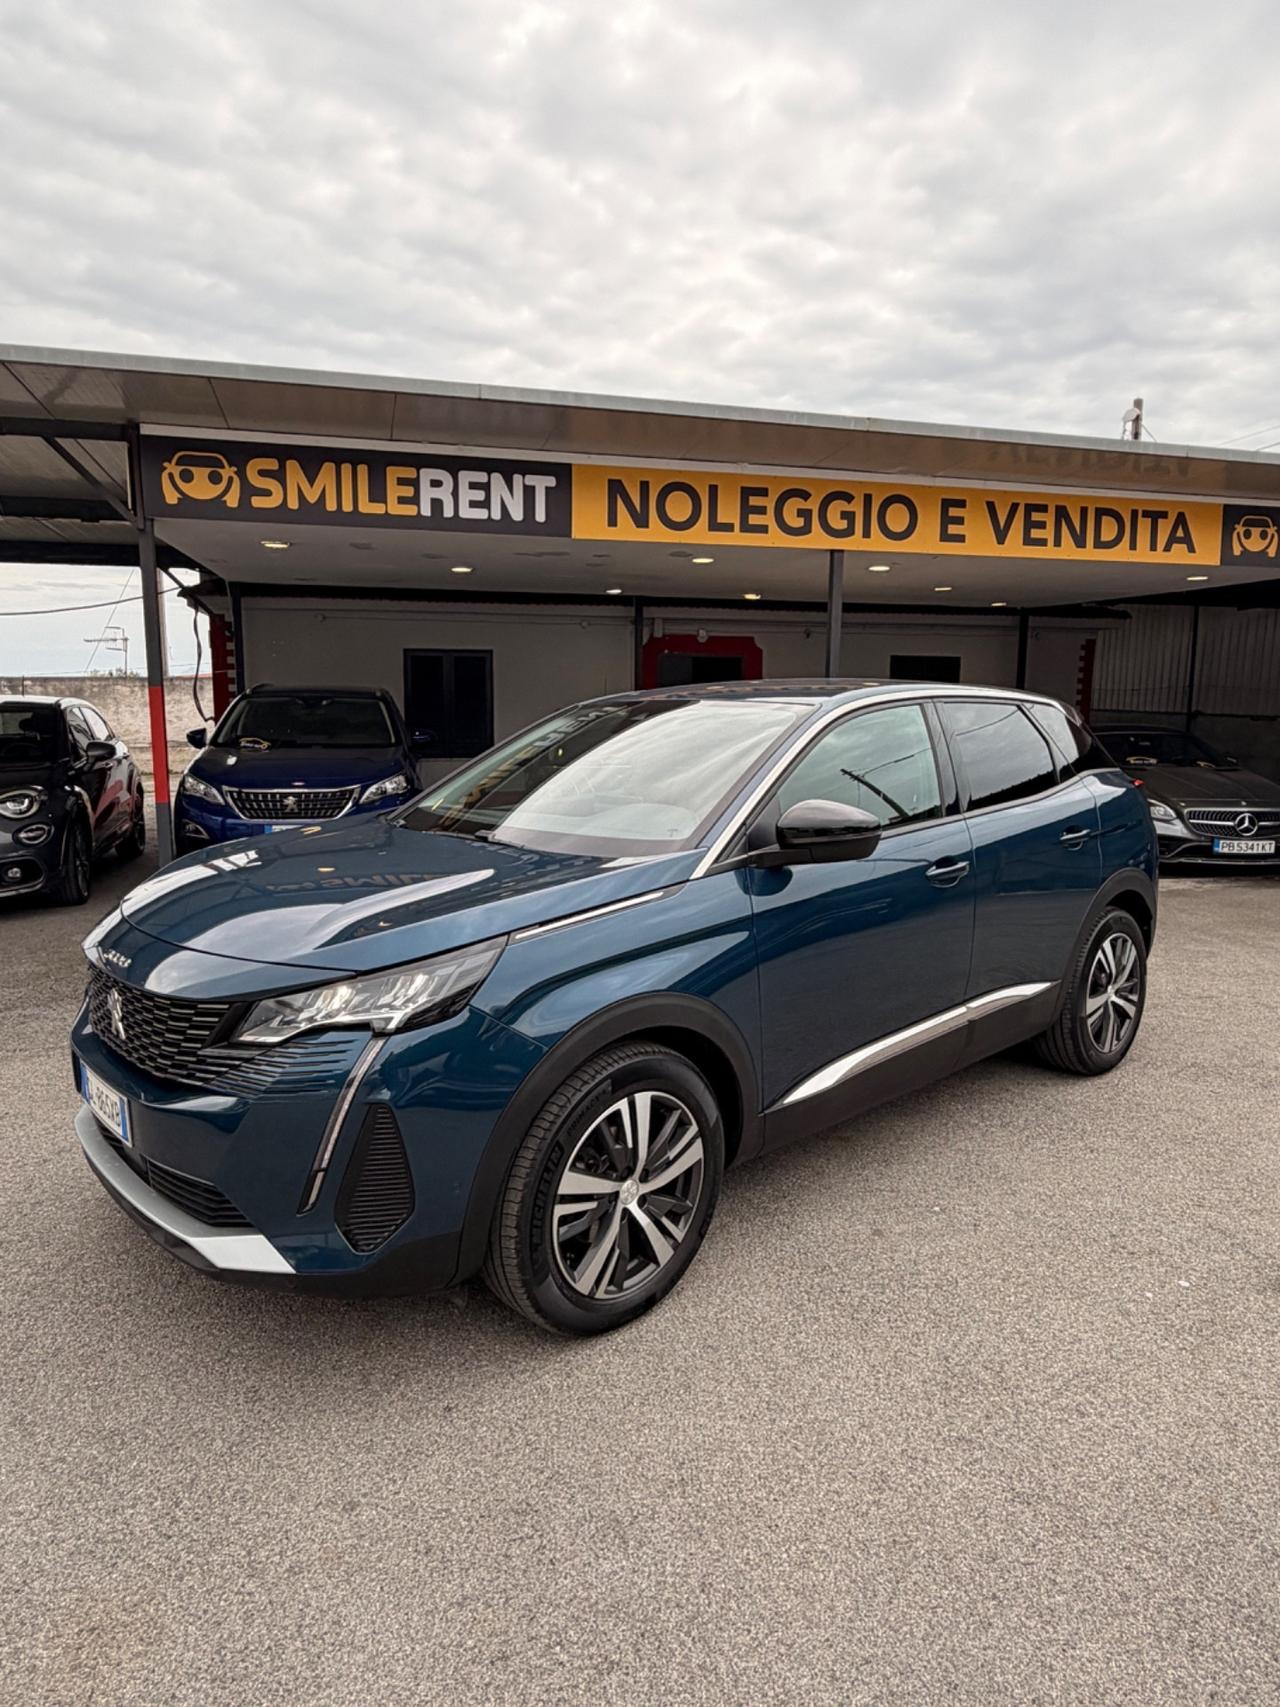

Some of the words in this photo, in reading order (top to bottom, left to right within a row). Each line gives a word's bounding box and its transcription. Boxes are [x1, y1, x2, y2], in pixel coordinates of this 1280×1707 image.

[606, 478, 918, 542] NOLEGGIO
[939, 498, 967, 544] E
[985, 500, 1196, 554] VENDITA
